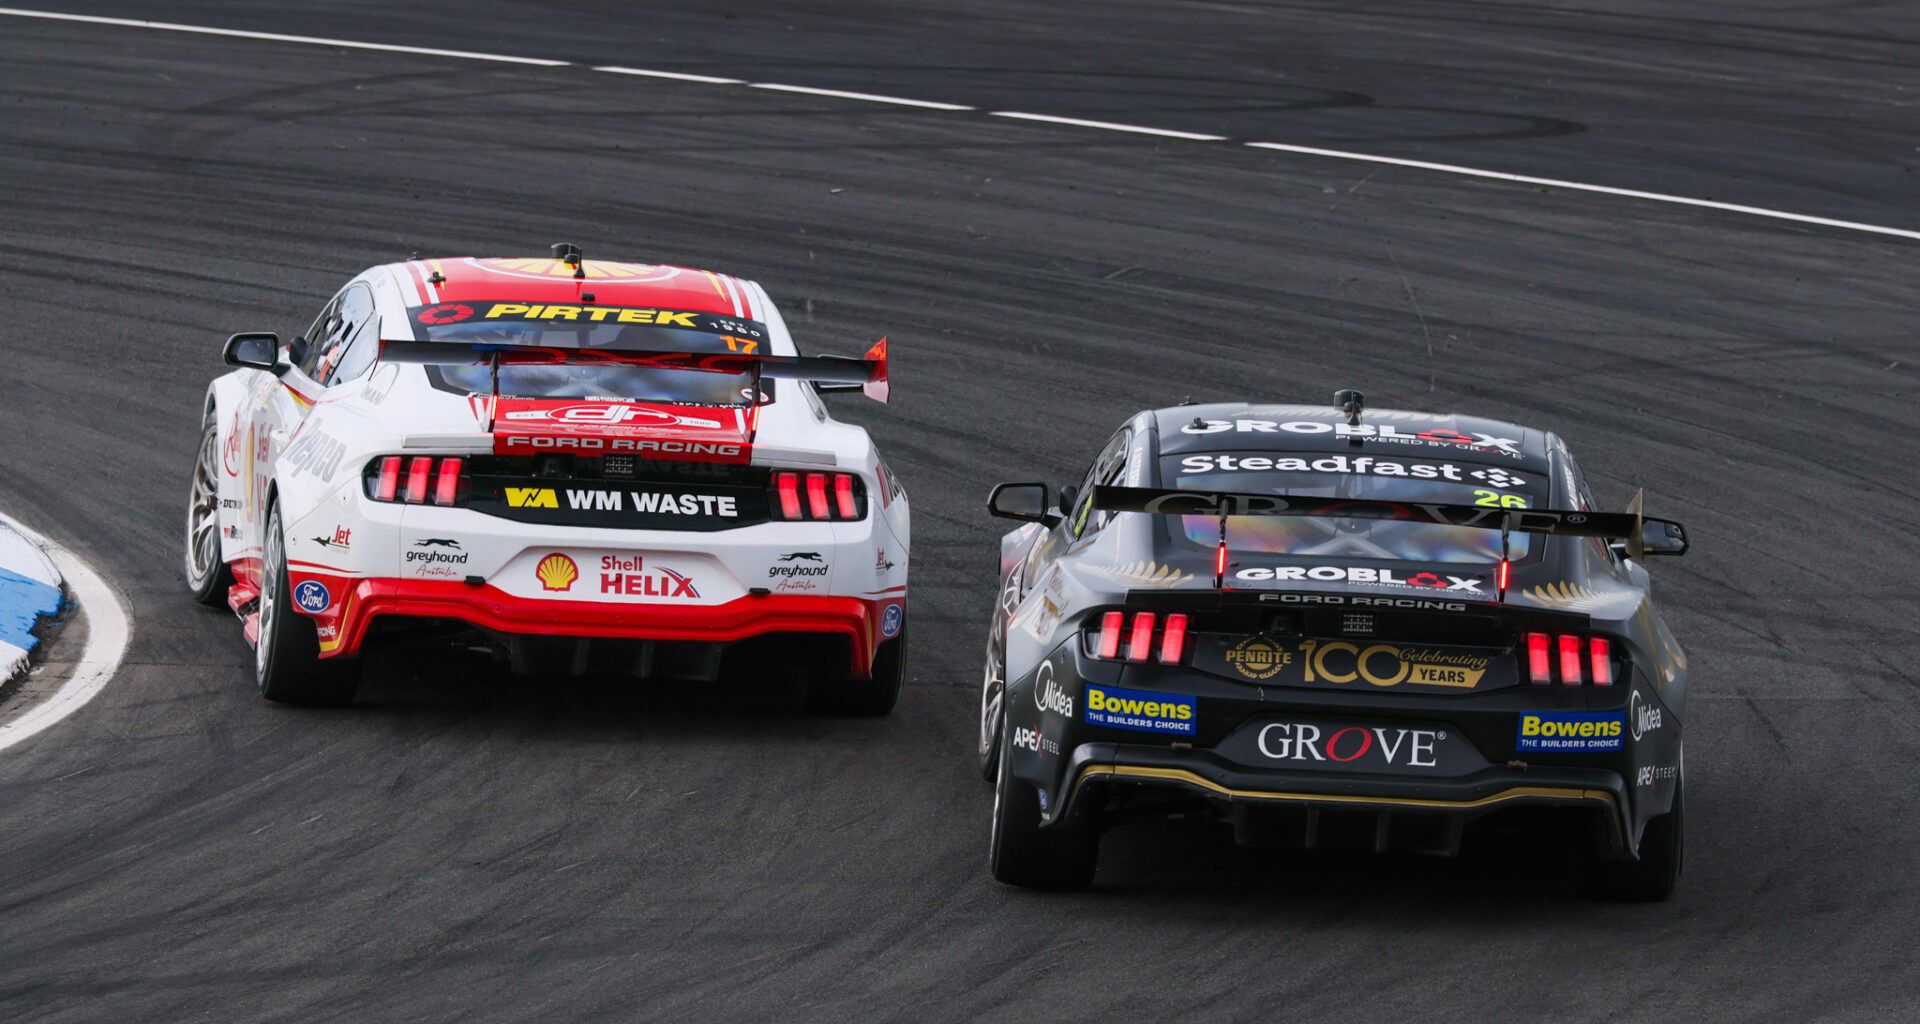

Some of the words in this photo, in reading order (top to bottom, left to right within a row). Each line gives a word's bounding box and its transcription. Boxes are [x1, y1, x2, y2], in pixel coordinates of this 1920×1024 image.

[484, 302, 701, 328] PIRTEK
[710, 322, 760, 337] 1980
[720, 335, 758, 355] 17
[507, 436, 604, 449] FORD
[612, 438, 740, 456] RACING
[1335, 434, 1423, 446] PWERED
[1429, 441, 1450, 449] BY
[1181, 454, 1461, 480] Steadfast
[565, 488, 623, 512] WM
[630, 491, 738, 517] WASTE
[1473, 490, 1528, 509] 26
[332, 524, 352, 545] Jet
[406, 550, 469, 564] greyhound
[601, 555, 643, 572] Shell
[415, 564, 459, 577] Australia
[768, 564, 829, 578] greyhound
[600, 573, 700, 599] HELIX
[1348, 581, 1412, 589] POWERED
[301, 584, 324, 609] Ford
[1259, 593, 1341, 605] FORD
[1351, 596, 1467, 612] RACING
[1225, 649, 1292, 664] PENRITE
[1299, 639, 1410, 687] 100
[1398, 646, 1490, 671] Celebrating
[1419, 667, 1466, 684] YEARS
[1034, 659, 1073, 718] Midea
[1088, 688, 1192, 720] Bowens
[1088, 712, 1104, 722] THE
[1107, 715, 1153, 728] BUILDERS
[1155, 720, 1191, 731] CHOICE
[1630, 689, 1661, 742] Midea
[1522, 715, 1622, 737] Bowens
[1013, 725, 1042, 757] APEX
[1042, 738, 1060, 756] STEEL
[1521, 739, 1538, 747] THE
[1541, 739, 1586, 748] BUILDERS
[1588, 739, 1620, 748] CHOICE
